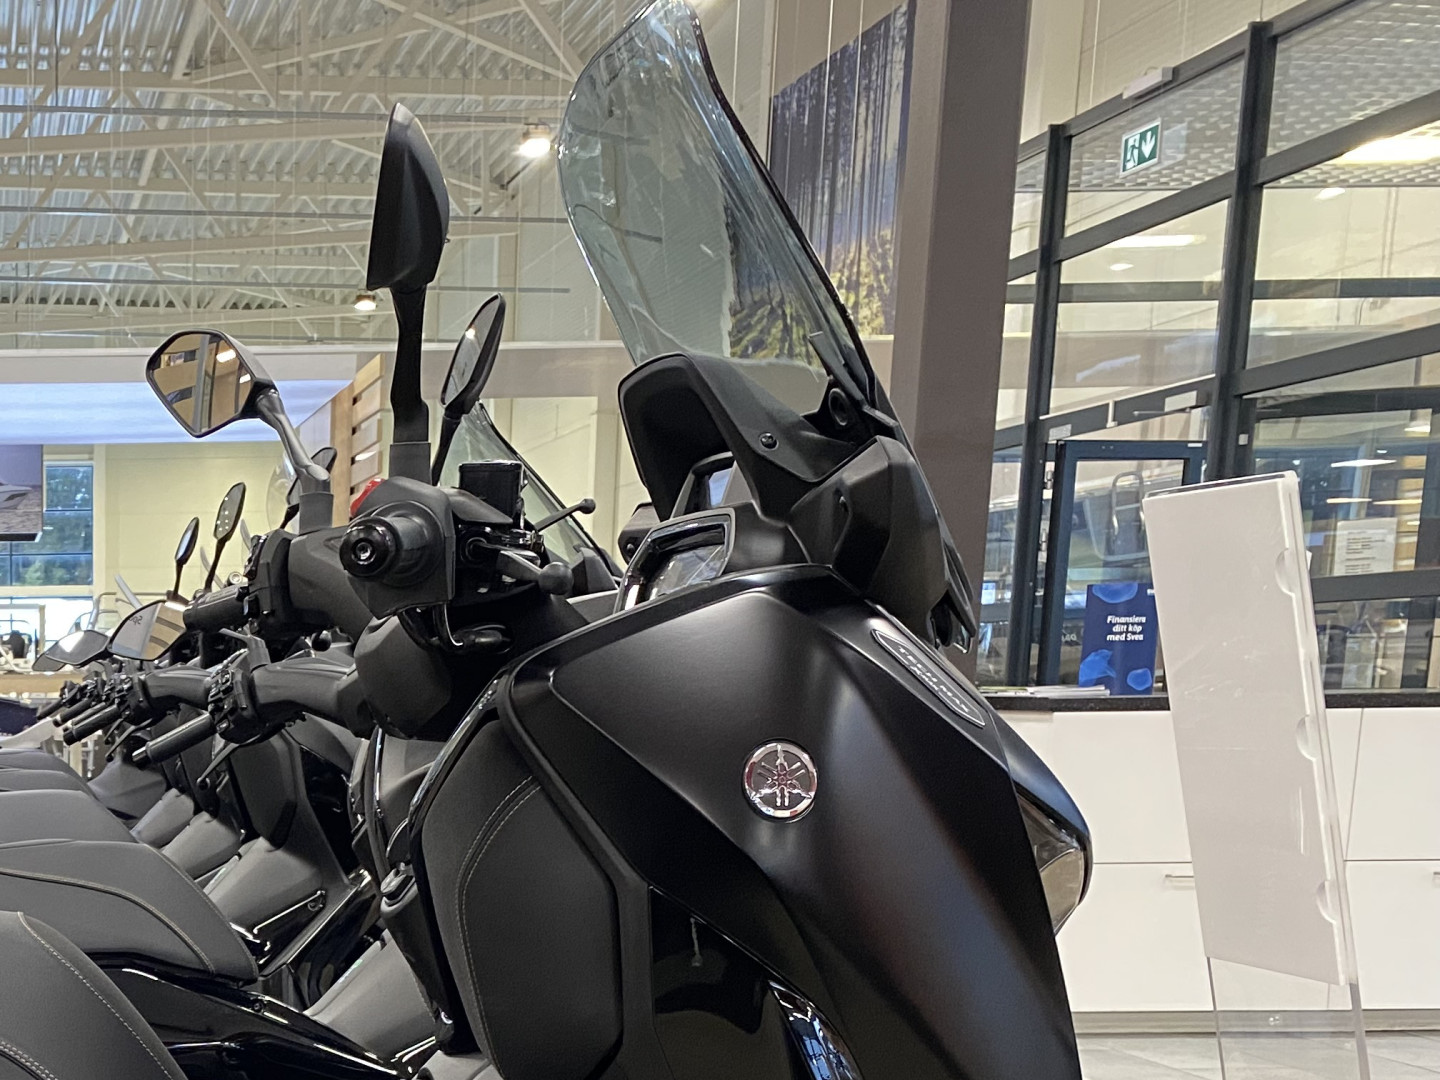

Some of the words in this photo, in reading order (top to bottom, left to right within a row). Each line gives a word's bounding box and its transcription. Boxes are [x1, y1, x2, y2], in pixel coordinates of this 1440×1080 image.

[1106, 615, 1146, 623] Finansiera
[1112, 624, 1127, 632] ditt
[1128, 624, 1143, 633] köp
[1106, 632, 1126, 641] med
[1126, 632, 1144, 641] Svea
